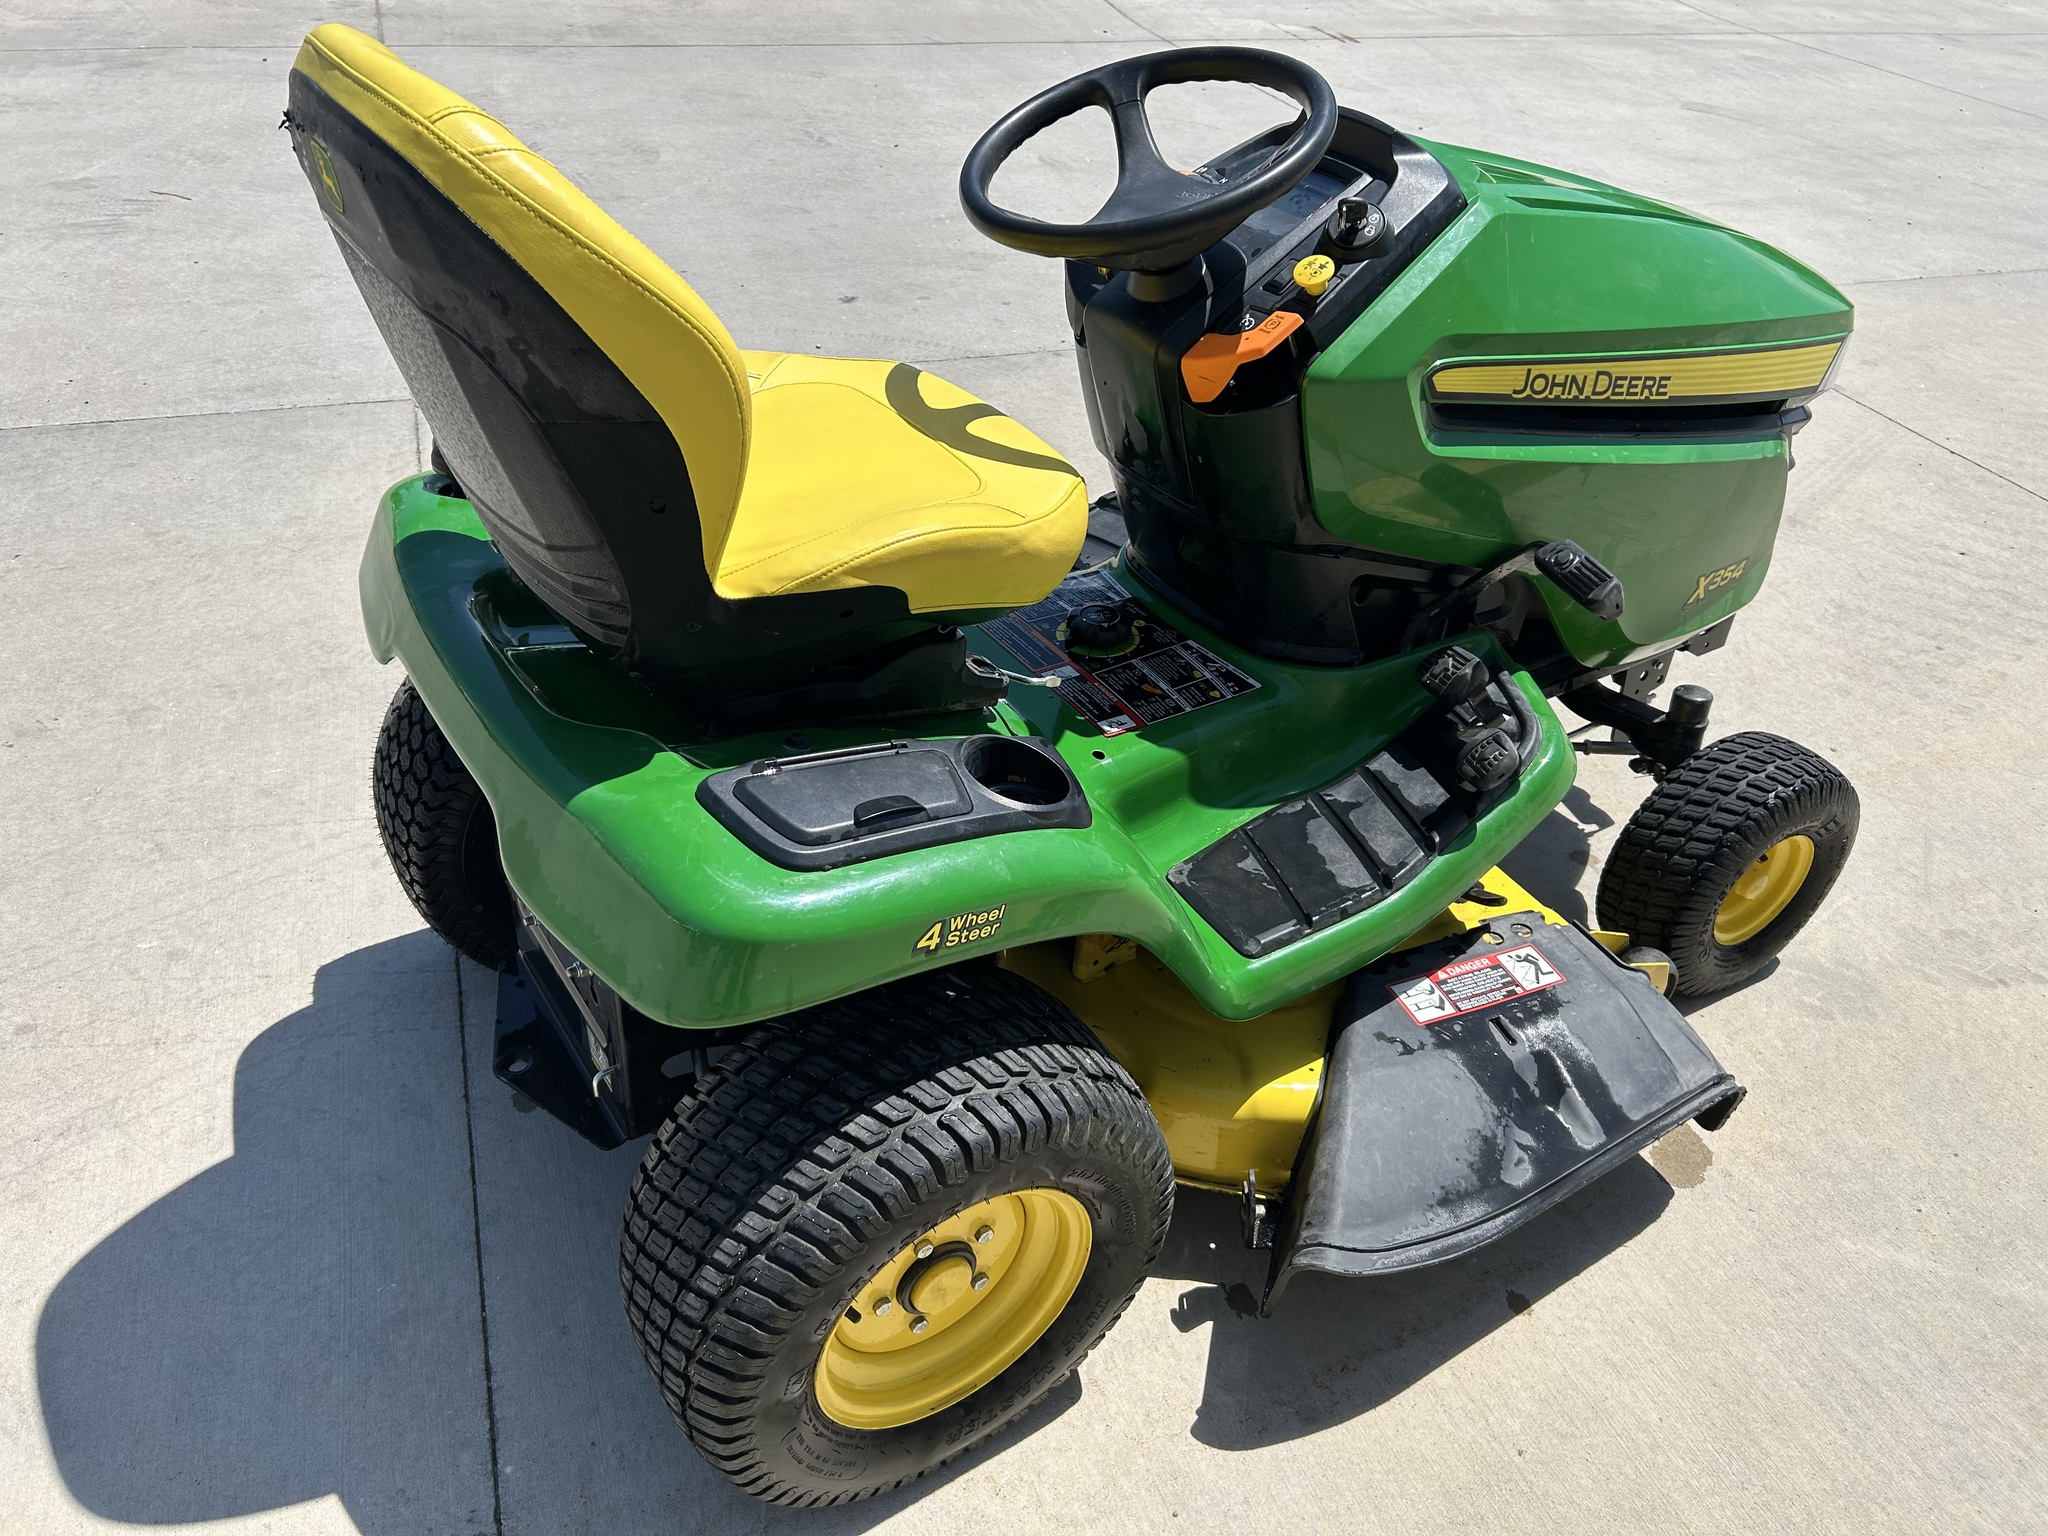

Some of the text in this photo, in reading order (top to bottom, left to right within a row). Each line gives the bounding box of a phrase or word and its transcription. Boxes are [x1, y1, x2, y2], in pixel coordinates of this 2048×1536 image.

[1512, 368, 1672, 397] JOHN DEERE
[1686, 559, 1747, 605] X354
[915, 904, 1006, 952] 4 Wheel
[945, 922, 1000, 947] Steer
[1446, 958, 1491, 975] DANGER
[945, 1298, 1111, 1446] TURF MASTER
